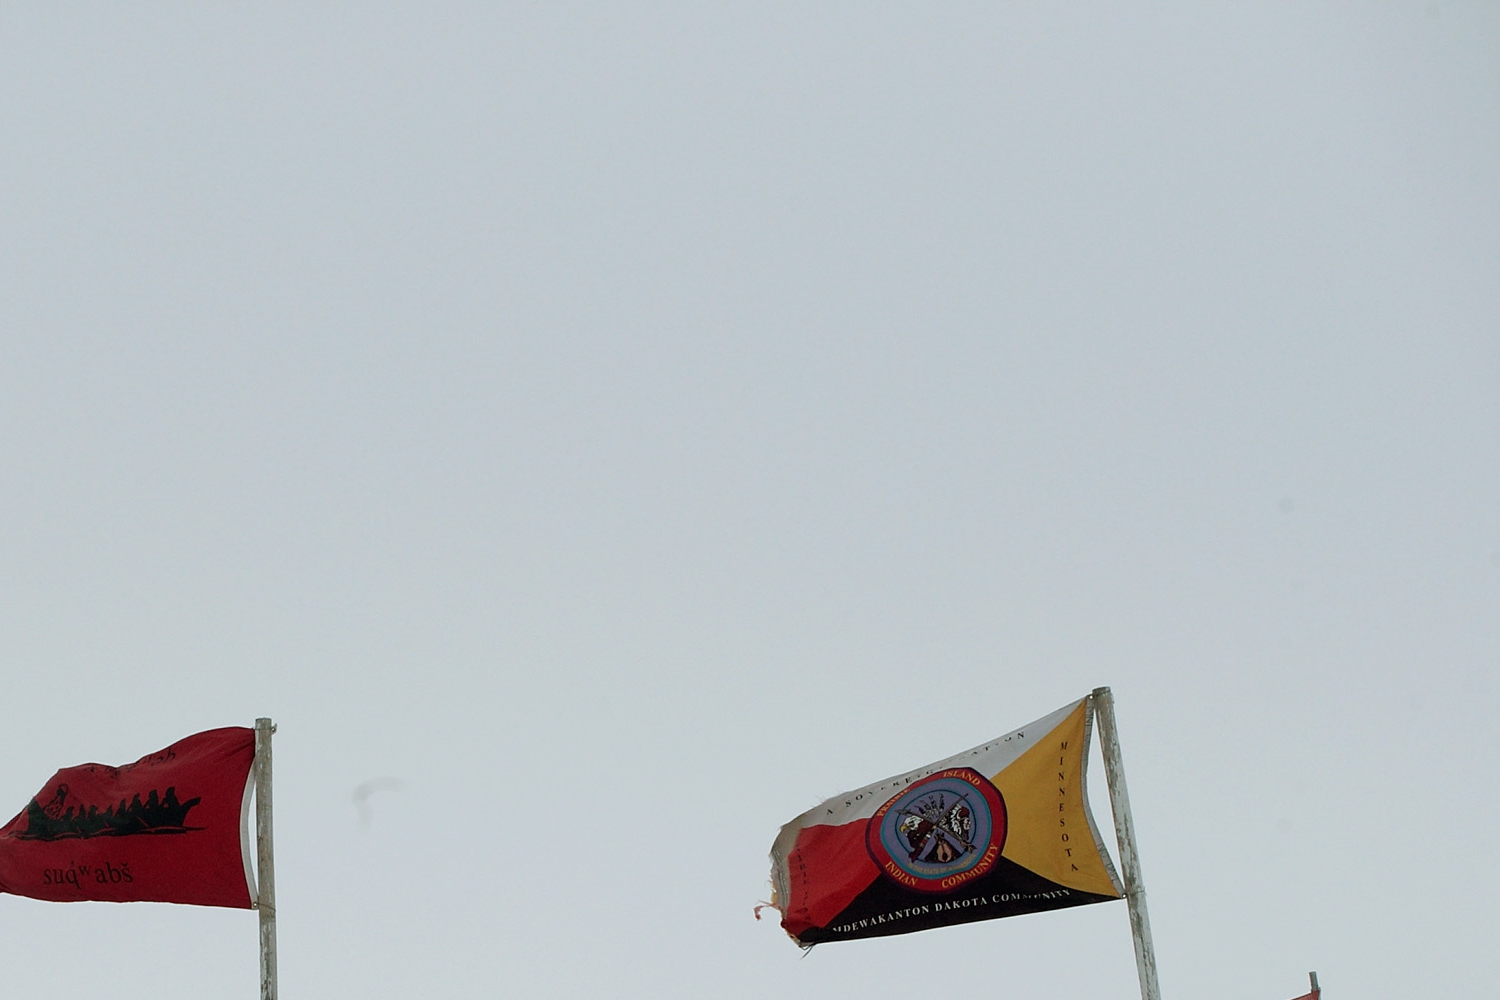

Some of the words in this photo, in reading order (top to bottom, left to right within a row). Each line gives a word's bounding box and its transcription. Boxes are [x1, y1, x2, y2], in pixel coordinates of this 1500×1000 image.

[943, 770, 981, 787] ISLAND
[1058, 741, 1079, 872] MINNESOTA
[885, 860, 918, 887] INDIAN
[941, 843, 999, 889] COMMUNITY
[934, 896, 988, 912] DAKOTA
